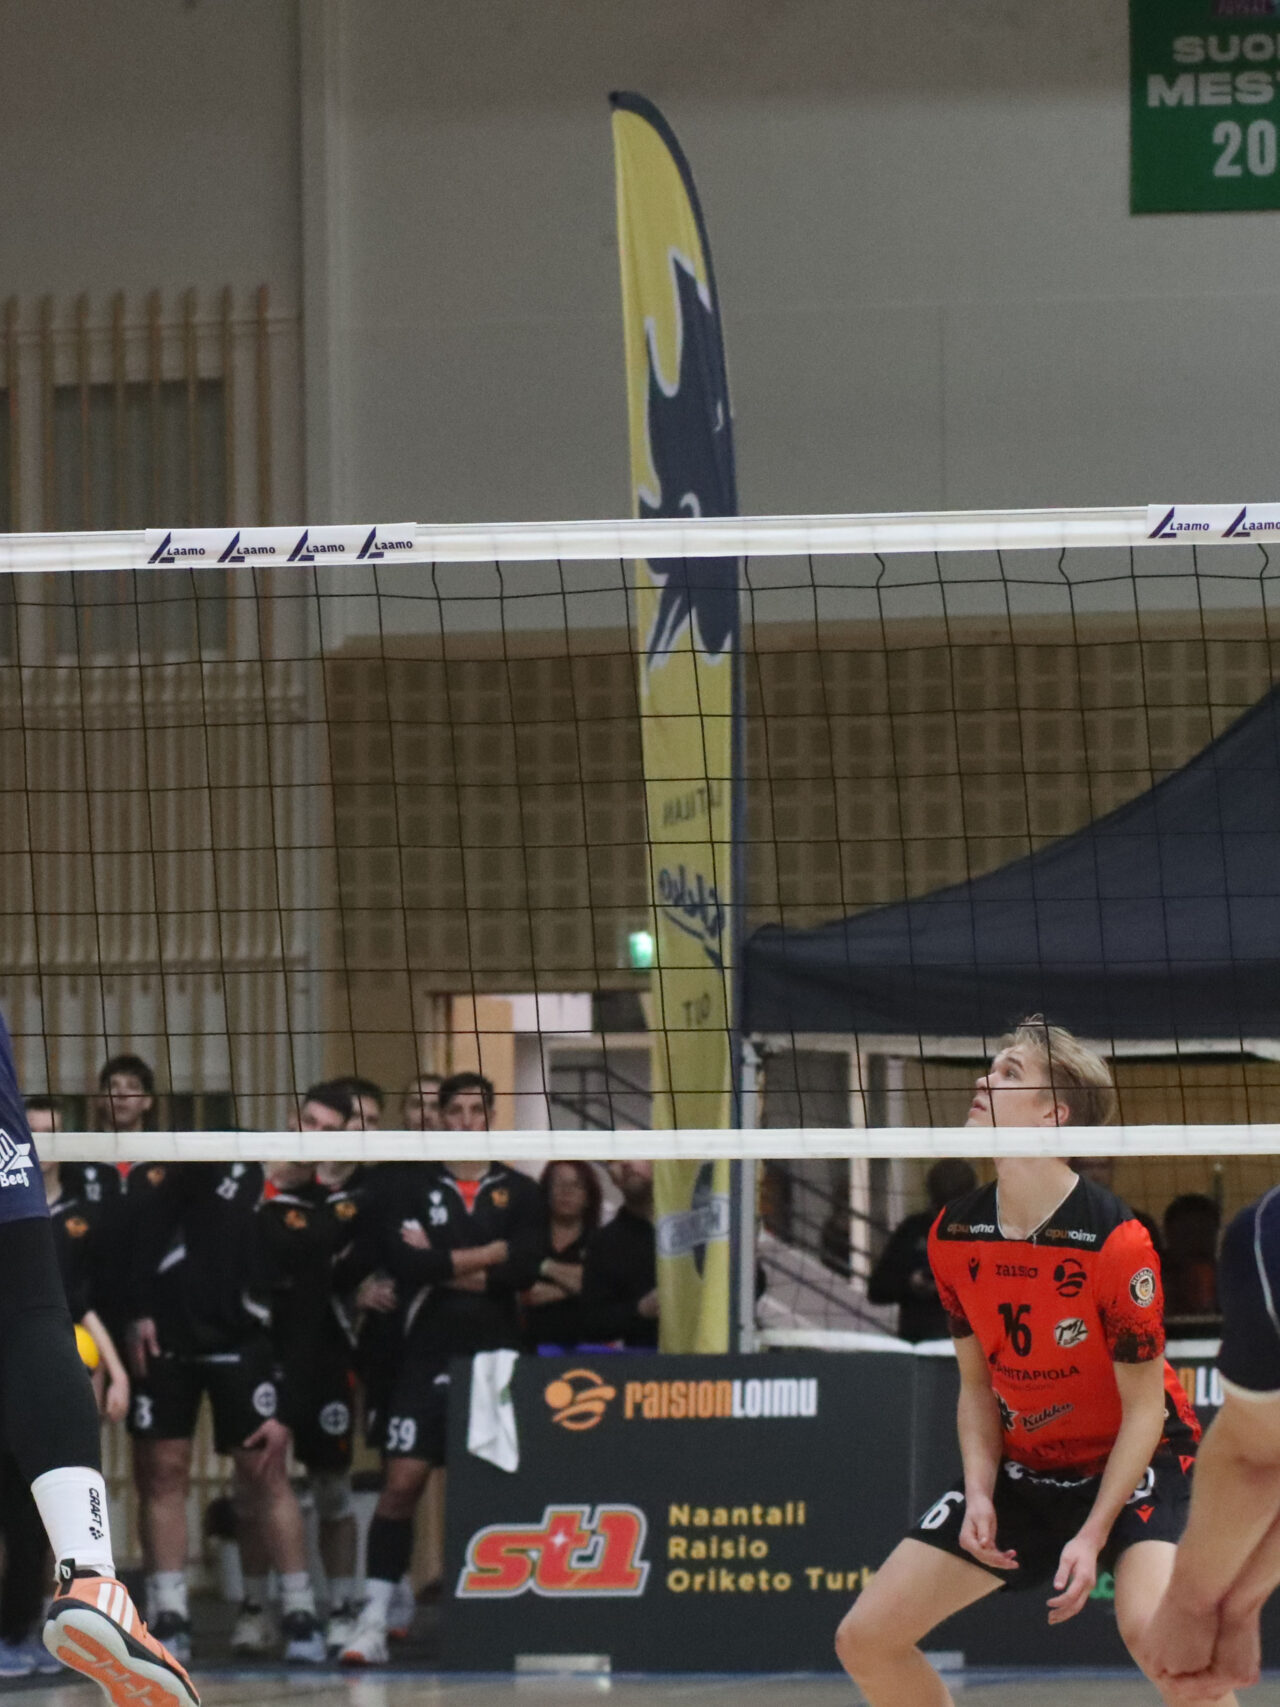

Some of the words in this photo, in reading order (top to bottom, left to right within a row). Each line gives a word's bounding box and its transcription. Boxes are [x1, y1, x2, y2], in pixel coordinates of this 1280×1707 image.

[1147, 71, 1280, 107] MES
[1169, 522, 1210, 531] Laamo
[167, 545, 206, 557] Laamo
[237, 544, 276, 556] Laamo
[306, 542, 346, 554] Laamo
[375, 539, 414, 551] Laamo
[998, 1302, 1032, 1358] 16
[386, 1416, 417, 1452] 59
[88, 1487, 102, 1528] CRAFT
[668, 1502, 806, 1527] Naantali
[667, 1534, 769, 1560] Raisio
[666, 1567, 793, 1593] Oriketo
